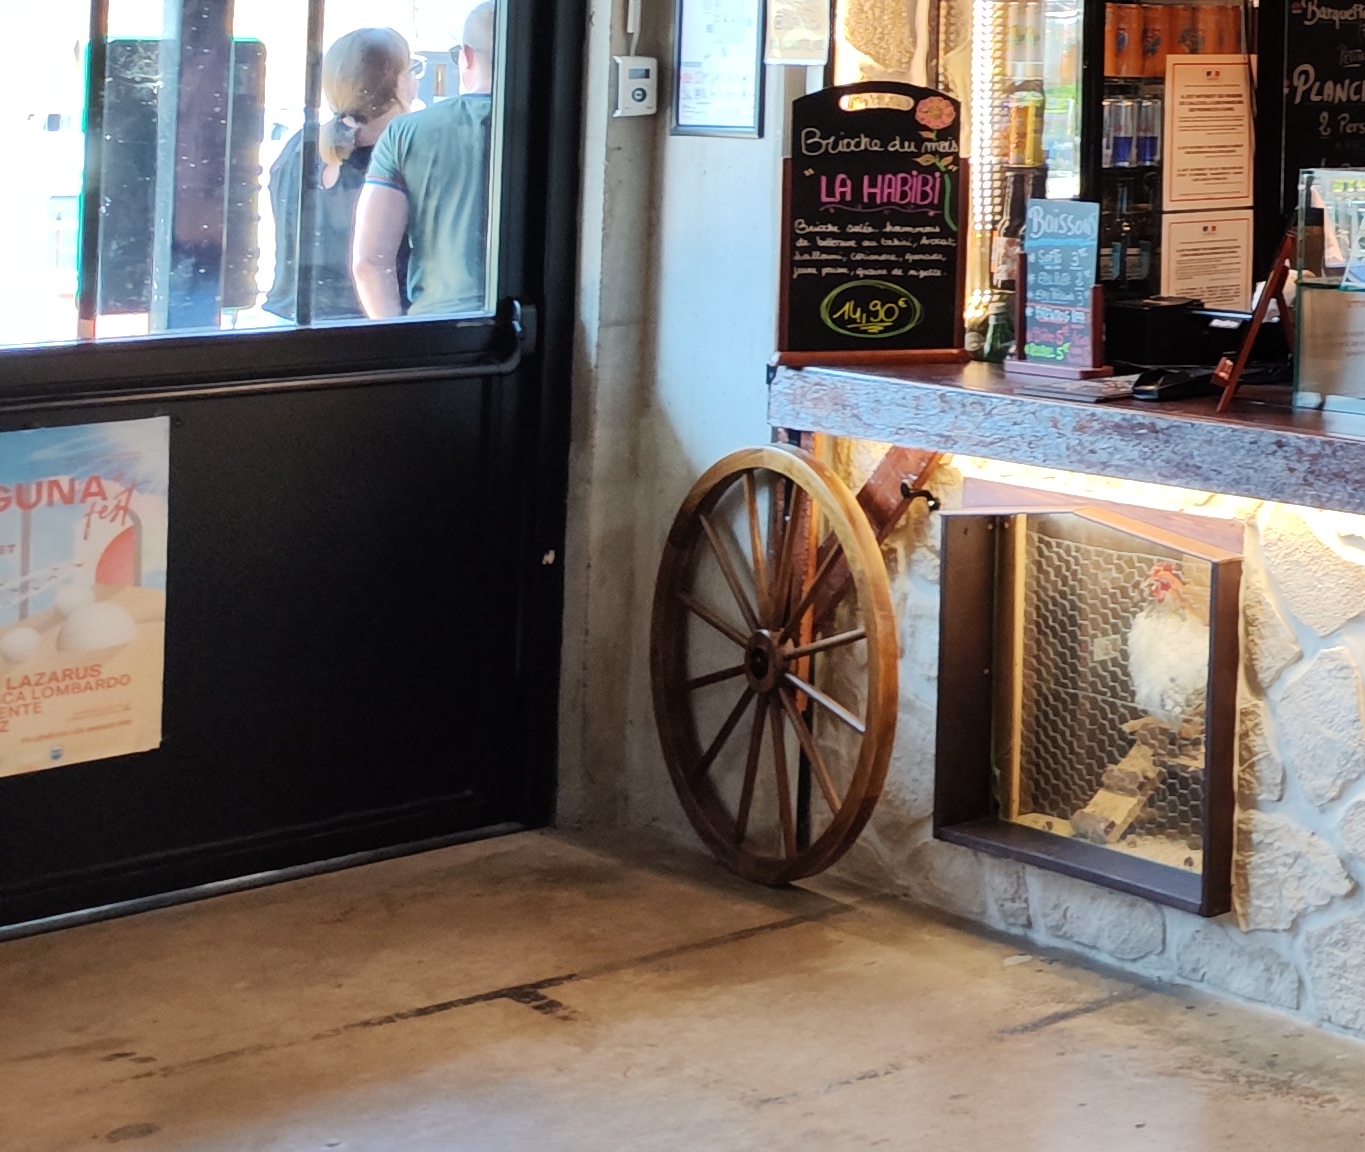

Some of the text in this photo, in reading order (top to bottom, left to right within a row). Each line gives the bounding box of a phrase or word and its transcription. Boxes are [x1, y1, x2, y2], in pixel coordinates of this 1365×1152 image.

[801, 128, 959, 156] Brioche du mois
[820, 170, 941, 205] LA HABIBI
[6, 664, 102, 690] LAZARUS
[31, 674, 131, 700] LOMBARDO
